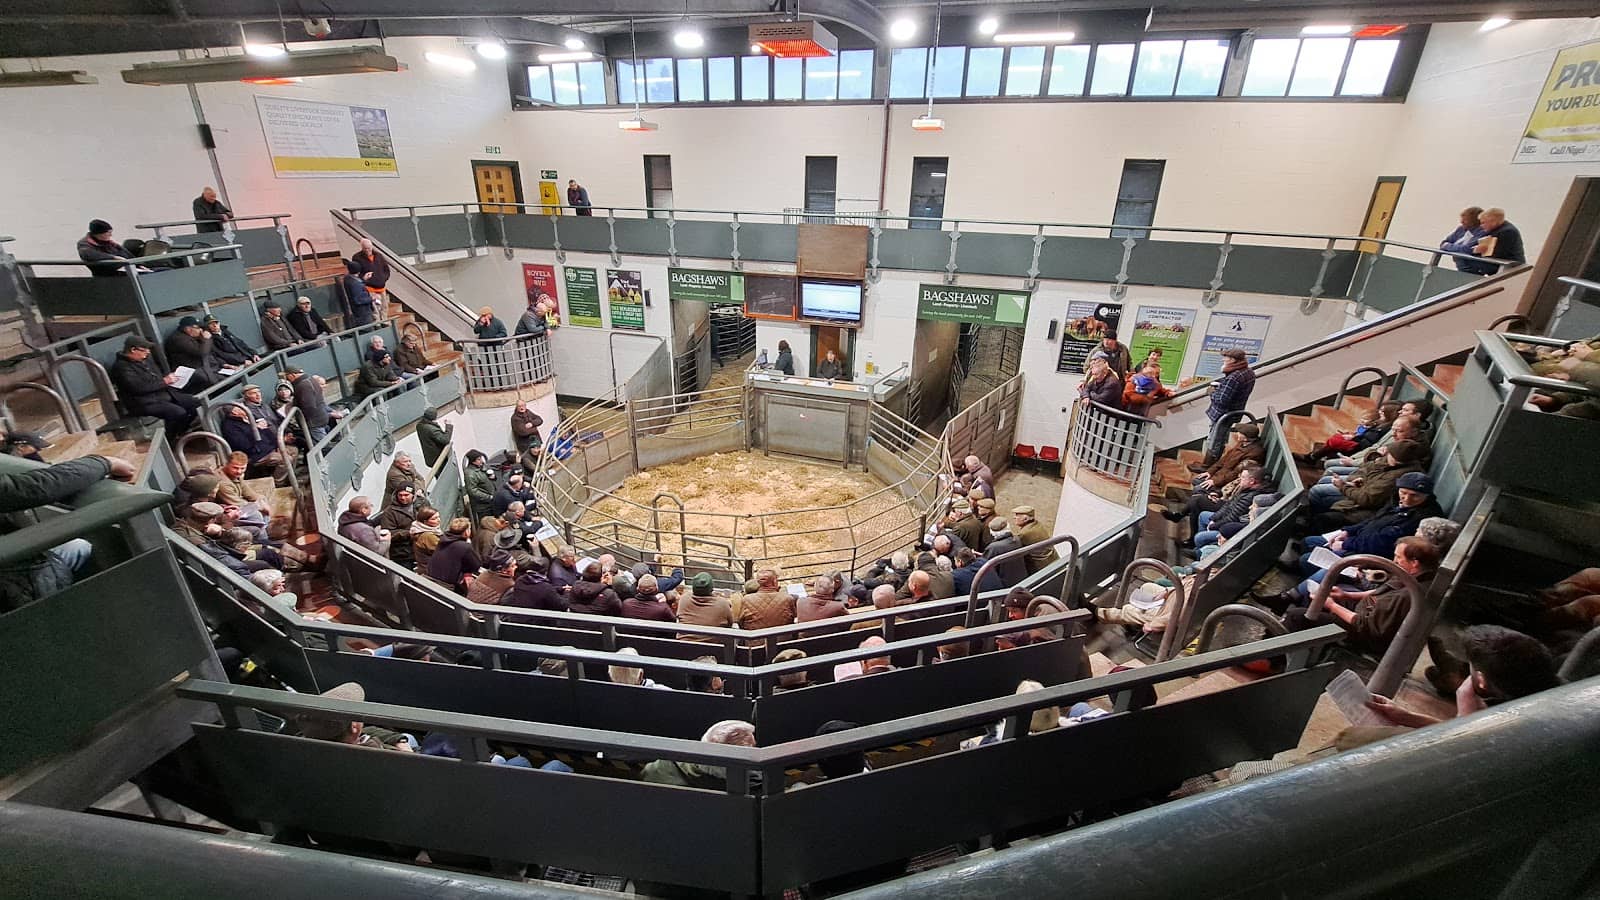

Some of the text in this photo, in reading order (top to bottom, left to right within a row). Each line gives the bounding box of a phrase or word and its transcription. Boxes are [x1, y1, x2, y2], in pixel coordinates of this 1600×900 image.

[1546, 97, 1583, 112] YOUR
[672, 272, 724, 286] BAGSHAWS
[924, 290, 990, 305] BAGSHAWS
